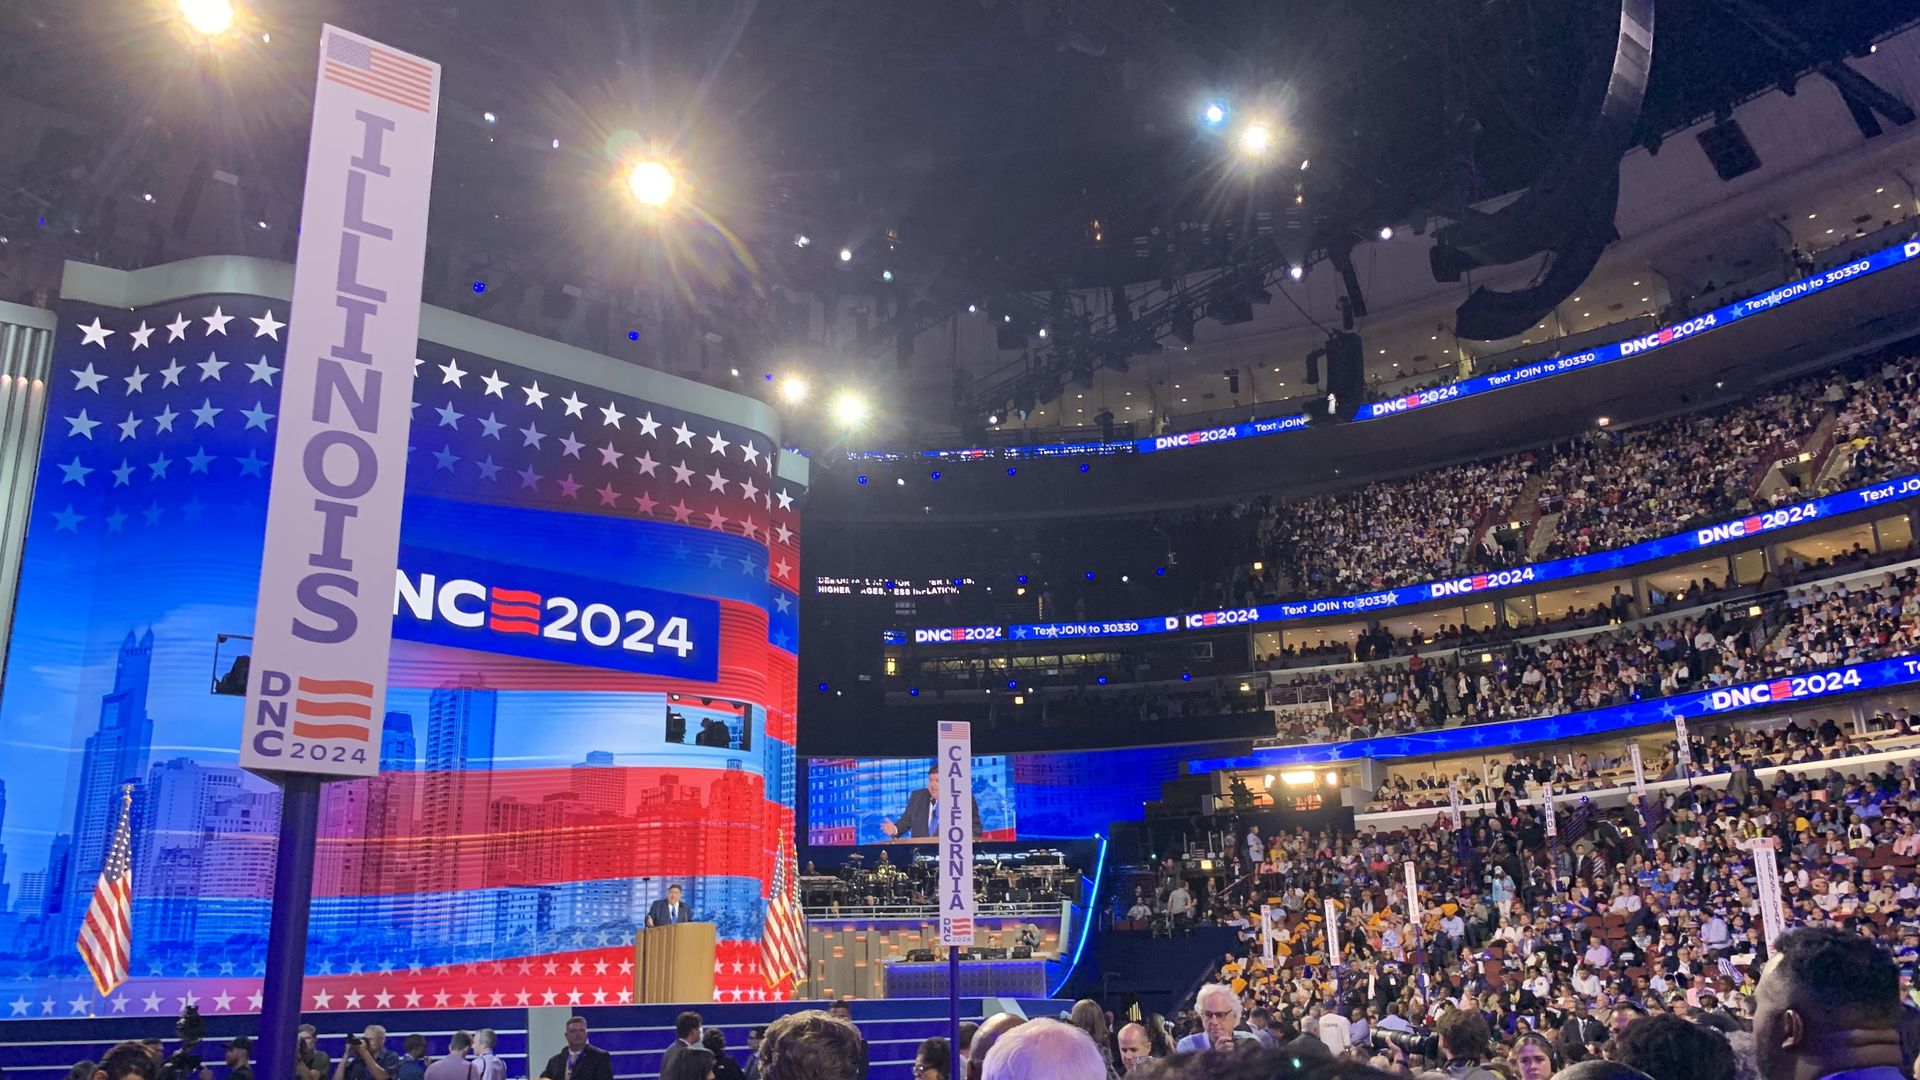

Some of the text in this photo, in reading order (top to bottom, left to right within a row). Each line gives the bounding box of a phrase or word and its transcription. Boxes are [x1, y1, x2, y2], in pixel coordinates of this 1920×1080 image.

[1745, 260, 1870, 312] Text JOIN to 30330
[1619, 313, 1717, 356] DNC 2024
[291, 108, 395, 644] ILLINOIS
[1487, 352, 1596, 387] Text JOIN to 30330
[1372, 384, 1459, 416] DNC 2024
[1155, 426, 1237, 450] DNC 2024
[1254, 416, 1306, 433] Text JOIN
[1858, 484, 1895, 503] Text
[1697, 502, 1818, 545] DNC 2024
[818, 585, 851, 595] HIGHER
[860, 586, 888, 597] AGES,
[1430, 566, 1536, 598] DNC 2024
[392, 568, 695, 659] NC 2024
[1216, 608, 1260, 625] 2024
[1281, 591, 1397, 617] Text JOIN to 30330
[915, 626, 1002, 643] DNC 2024
[1032, 622, 1140, 639] Text JOIN to 30330
[1711, 668, 1862, 711] DNC 2024
[251, 669, 293, 758] DNC
[290, 741, 367, 765] 2024
[1677, 720, 1690, 757] GUAM
[1545, 788, 1554, 828] IDAHO
[948, 745, 965, 911] CALIFORNIA
[943, 917, 951, 943] DNC
[952, 935, 971, 943] 2024
